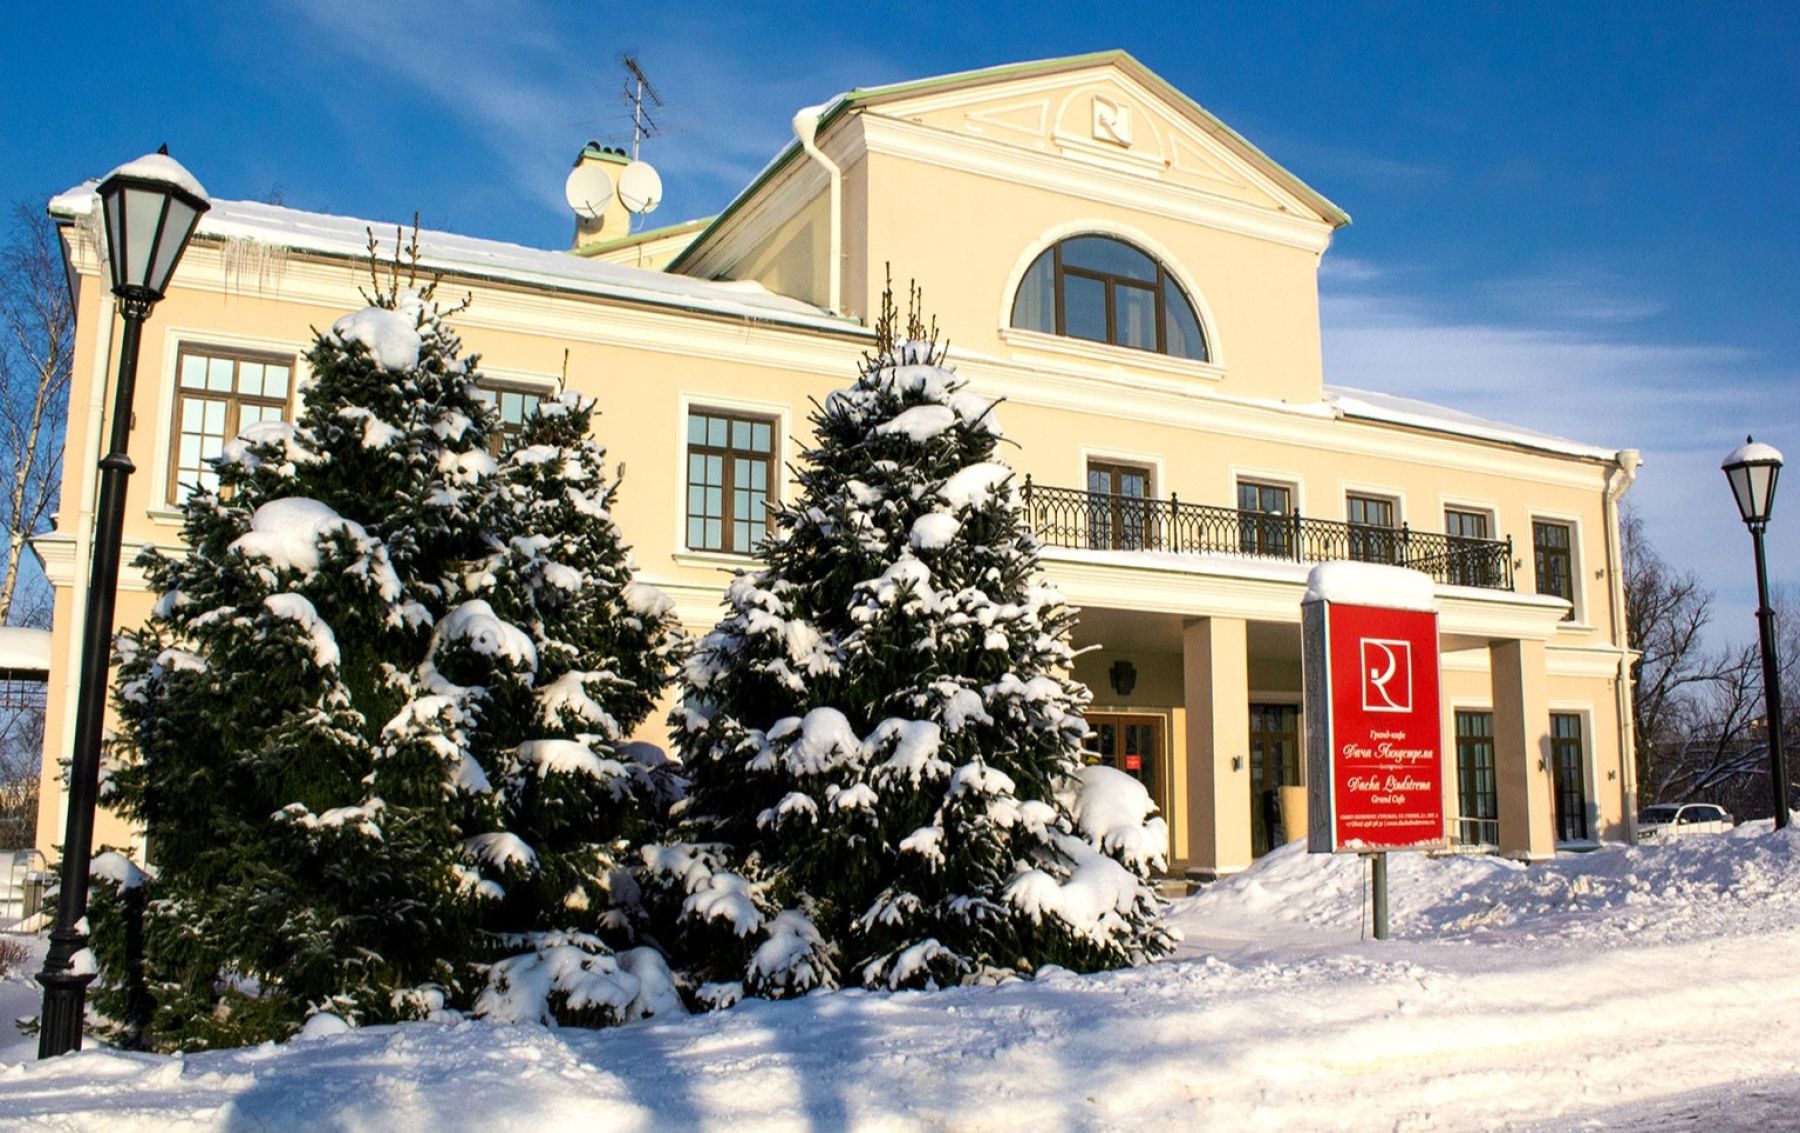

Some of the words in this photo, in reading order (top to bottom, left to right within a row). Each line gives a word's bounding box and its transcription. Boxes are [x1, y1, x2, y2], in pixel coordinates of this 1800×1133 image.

[1342, 743, 1372, 760] Дача
[1374, 742, 1434, 764] Линдстрема
[1347, 774, 1381, 793] Dacha
[1383, 774, 1432, 793] Lindstrema
[1371, 794, 1391, 804] Grand
